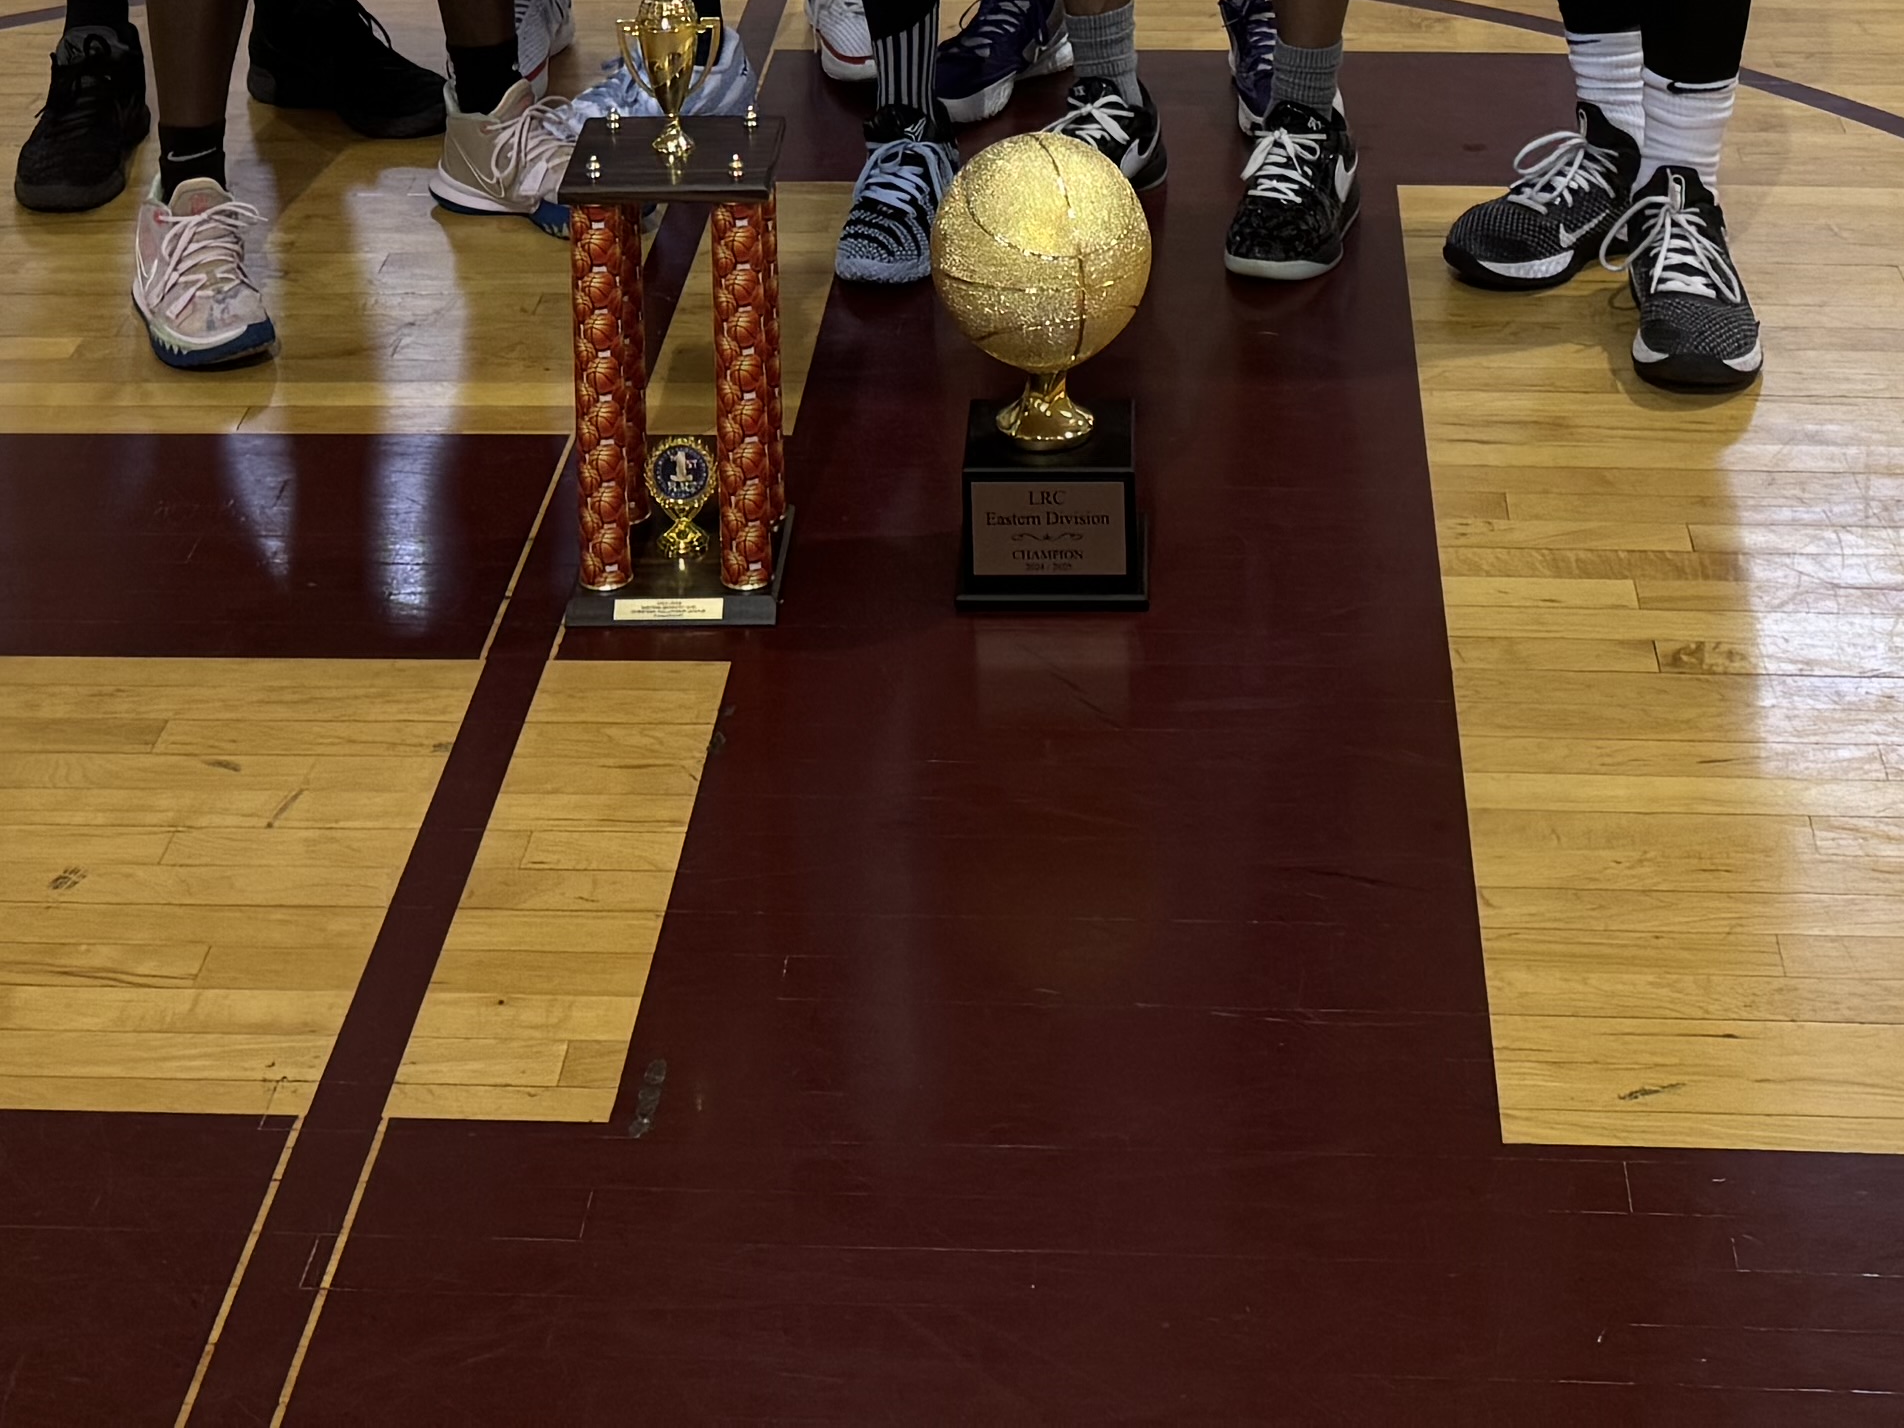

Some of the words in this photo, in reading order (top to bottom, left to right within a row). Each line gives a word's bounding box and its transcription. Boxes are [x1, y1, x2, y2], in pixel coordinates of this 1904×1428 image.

[1027, 490, 1066, 505] LRC
[986, 511, 1041, 526] Eastern
[1046, 510, 1110, 526] Division
[1012, 549, 1084, 560] CHAMPION
